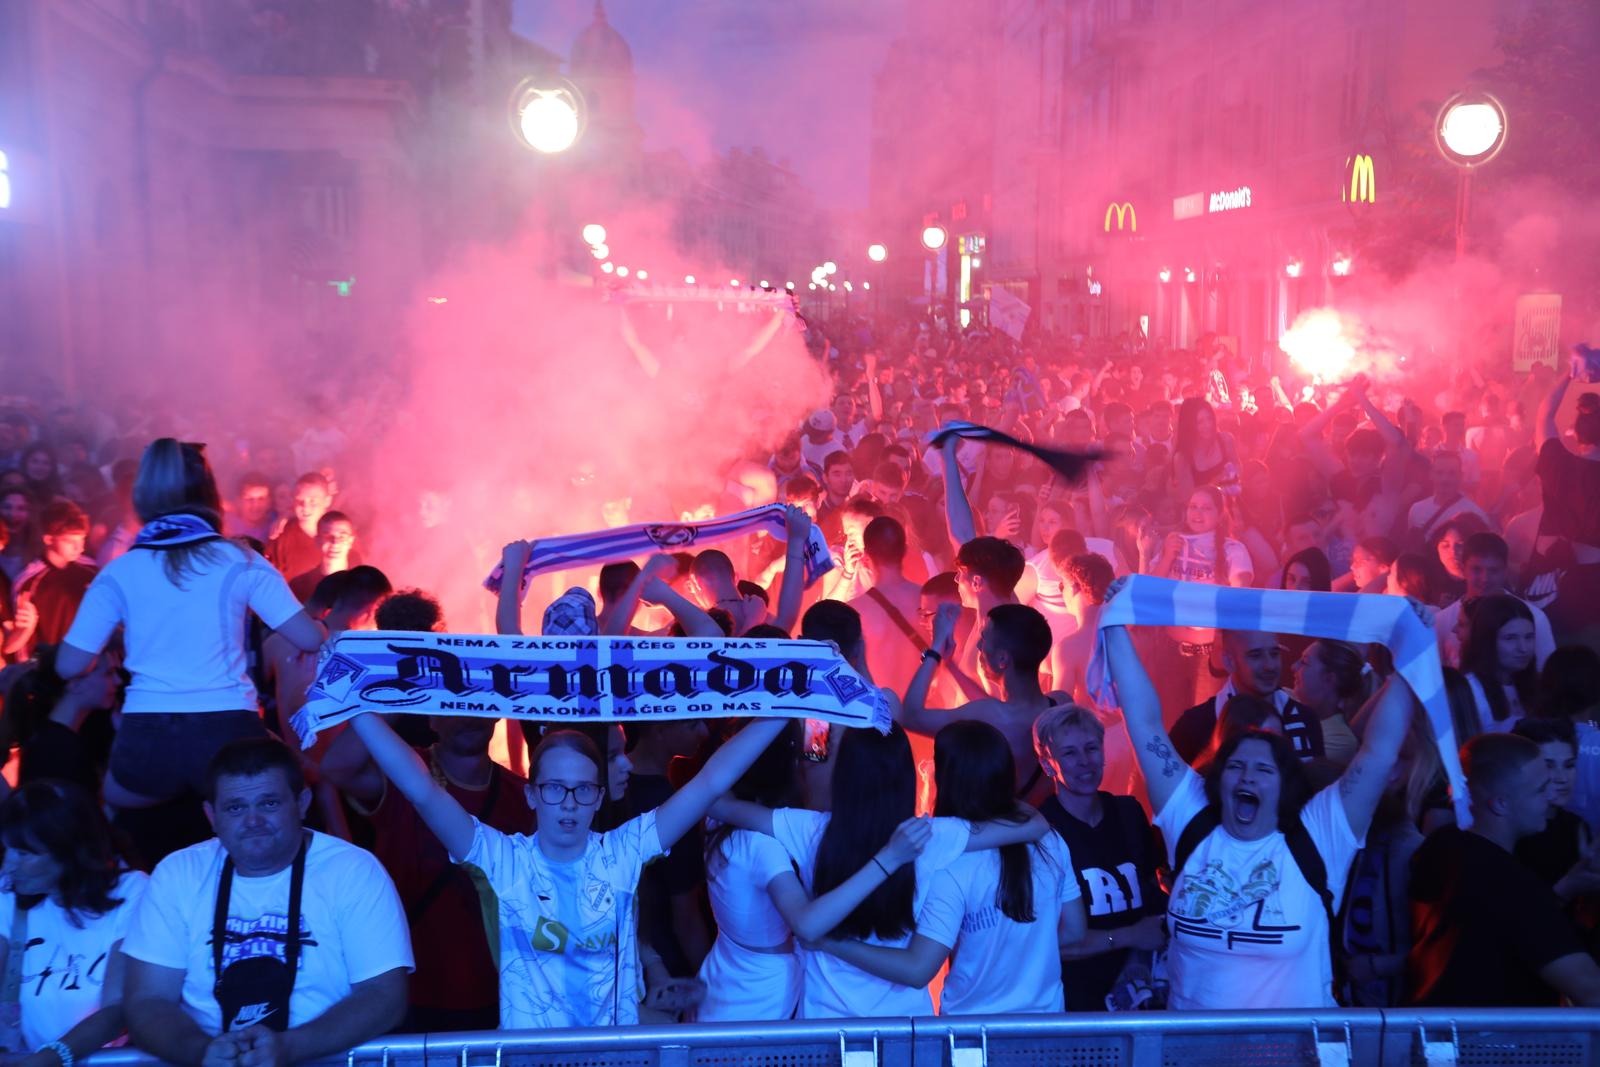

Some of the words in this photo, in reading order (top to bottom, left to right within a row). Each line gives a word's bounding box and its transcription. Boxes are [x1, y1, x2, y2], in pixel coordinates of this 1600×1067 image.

[1208, 186, 1251, 213] McDonald's
[436, 637, 500, 648] NEMA
[511, 640, 599, 650] ZAKONA
[686, 641, 713, 650] OD
[723, 641, 768, 649] NAS
[360, 643, 816, 704] Armada
[439, 701, 501, 712] NEMA
[511, 705, 602, 716] ZAKONA
[687, 703, 713, 712] OD
[722, 702, 762, 711] NAS
[1081, 862, 1143, 916] RI
